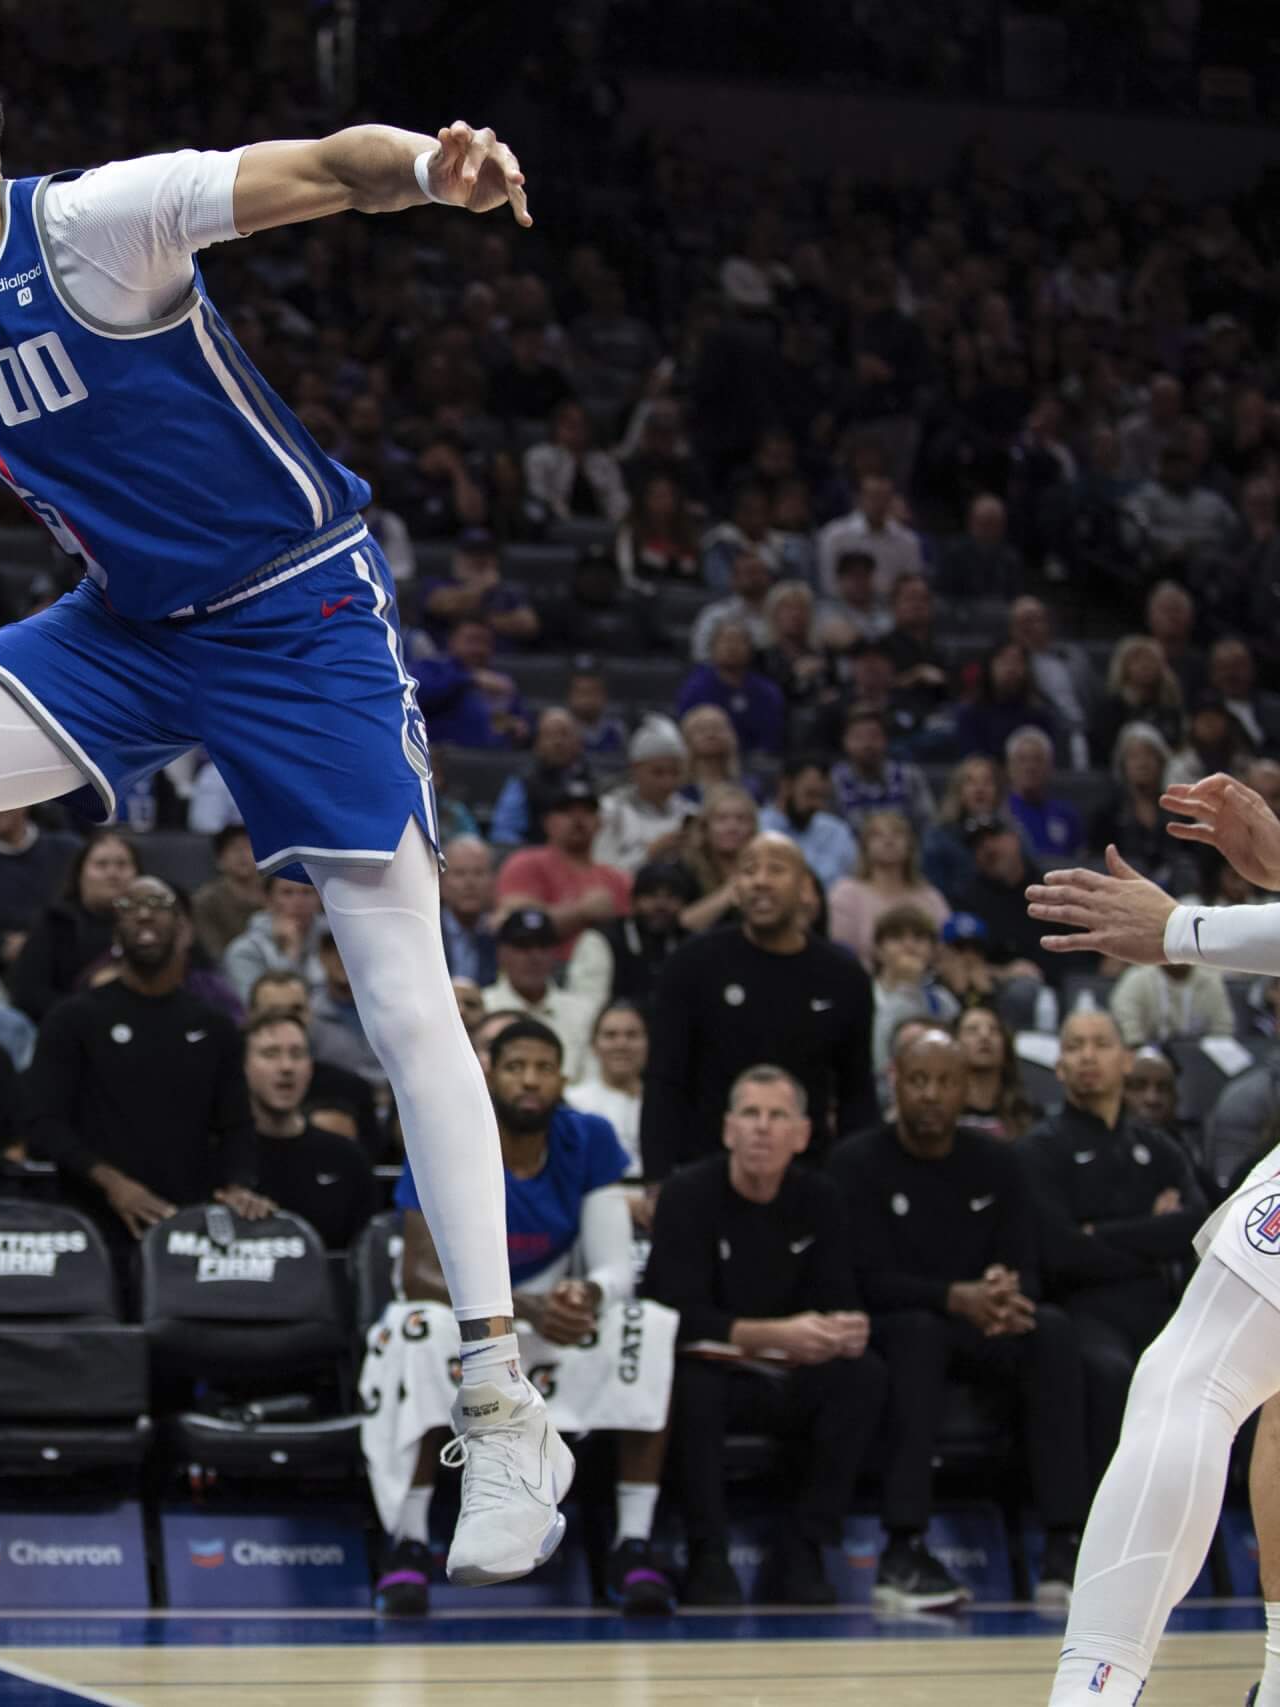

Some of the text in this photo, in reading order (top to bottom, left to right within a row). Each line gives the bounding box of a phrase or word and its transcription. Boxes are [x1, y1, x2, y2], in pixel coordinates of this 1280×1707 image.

[197, 1258, 276, 1282] FIRM
[8, 1539, 123, 1566] Chevron
[232, 1539, 344, 1566] Chevron
